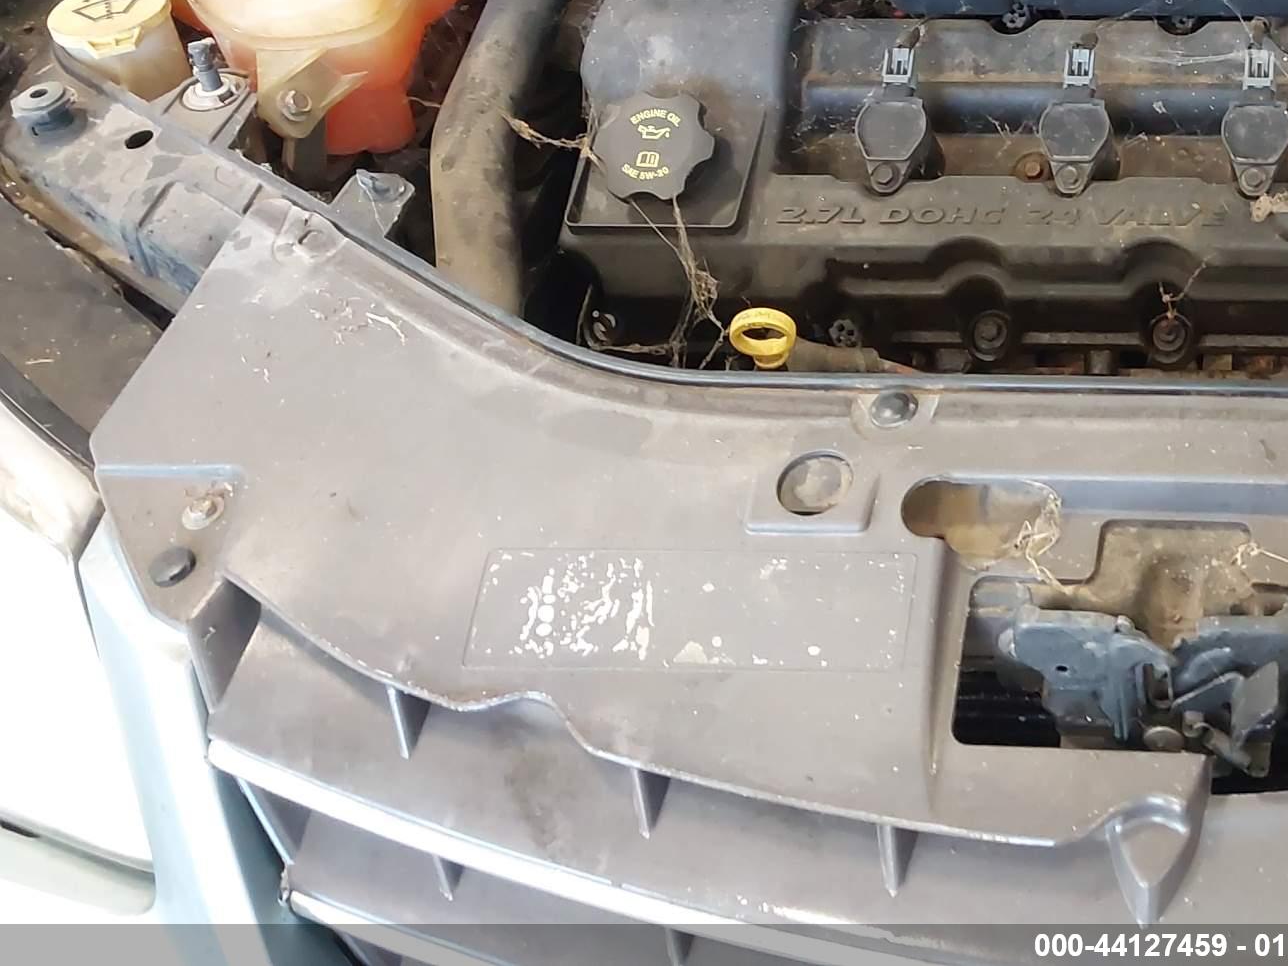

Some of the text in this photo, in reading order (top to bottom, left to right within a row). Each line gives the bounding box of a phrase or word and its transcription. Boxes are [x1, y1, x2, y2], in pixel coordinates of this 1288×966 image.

[630, 108, 681, 127] ENGINE OIL
[621, 163, 669, 180] SAE 5W-20
[776, 206, 866, 225] 2.7L
[878, 206, 1006, 225] DOHC
